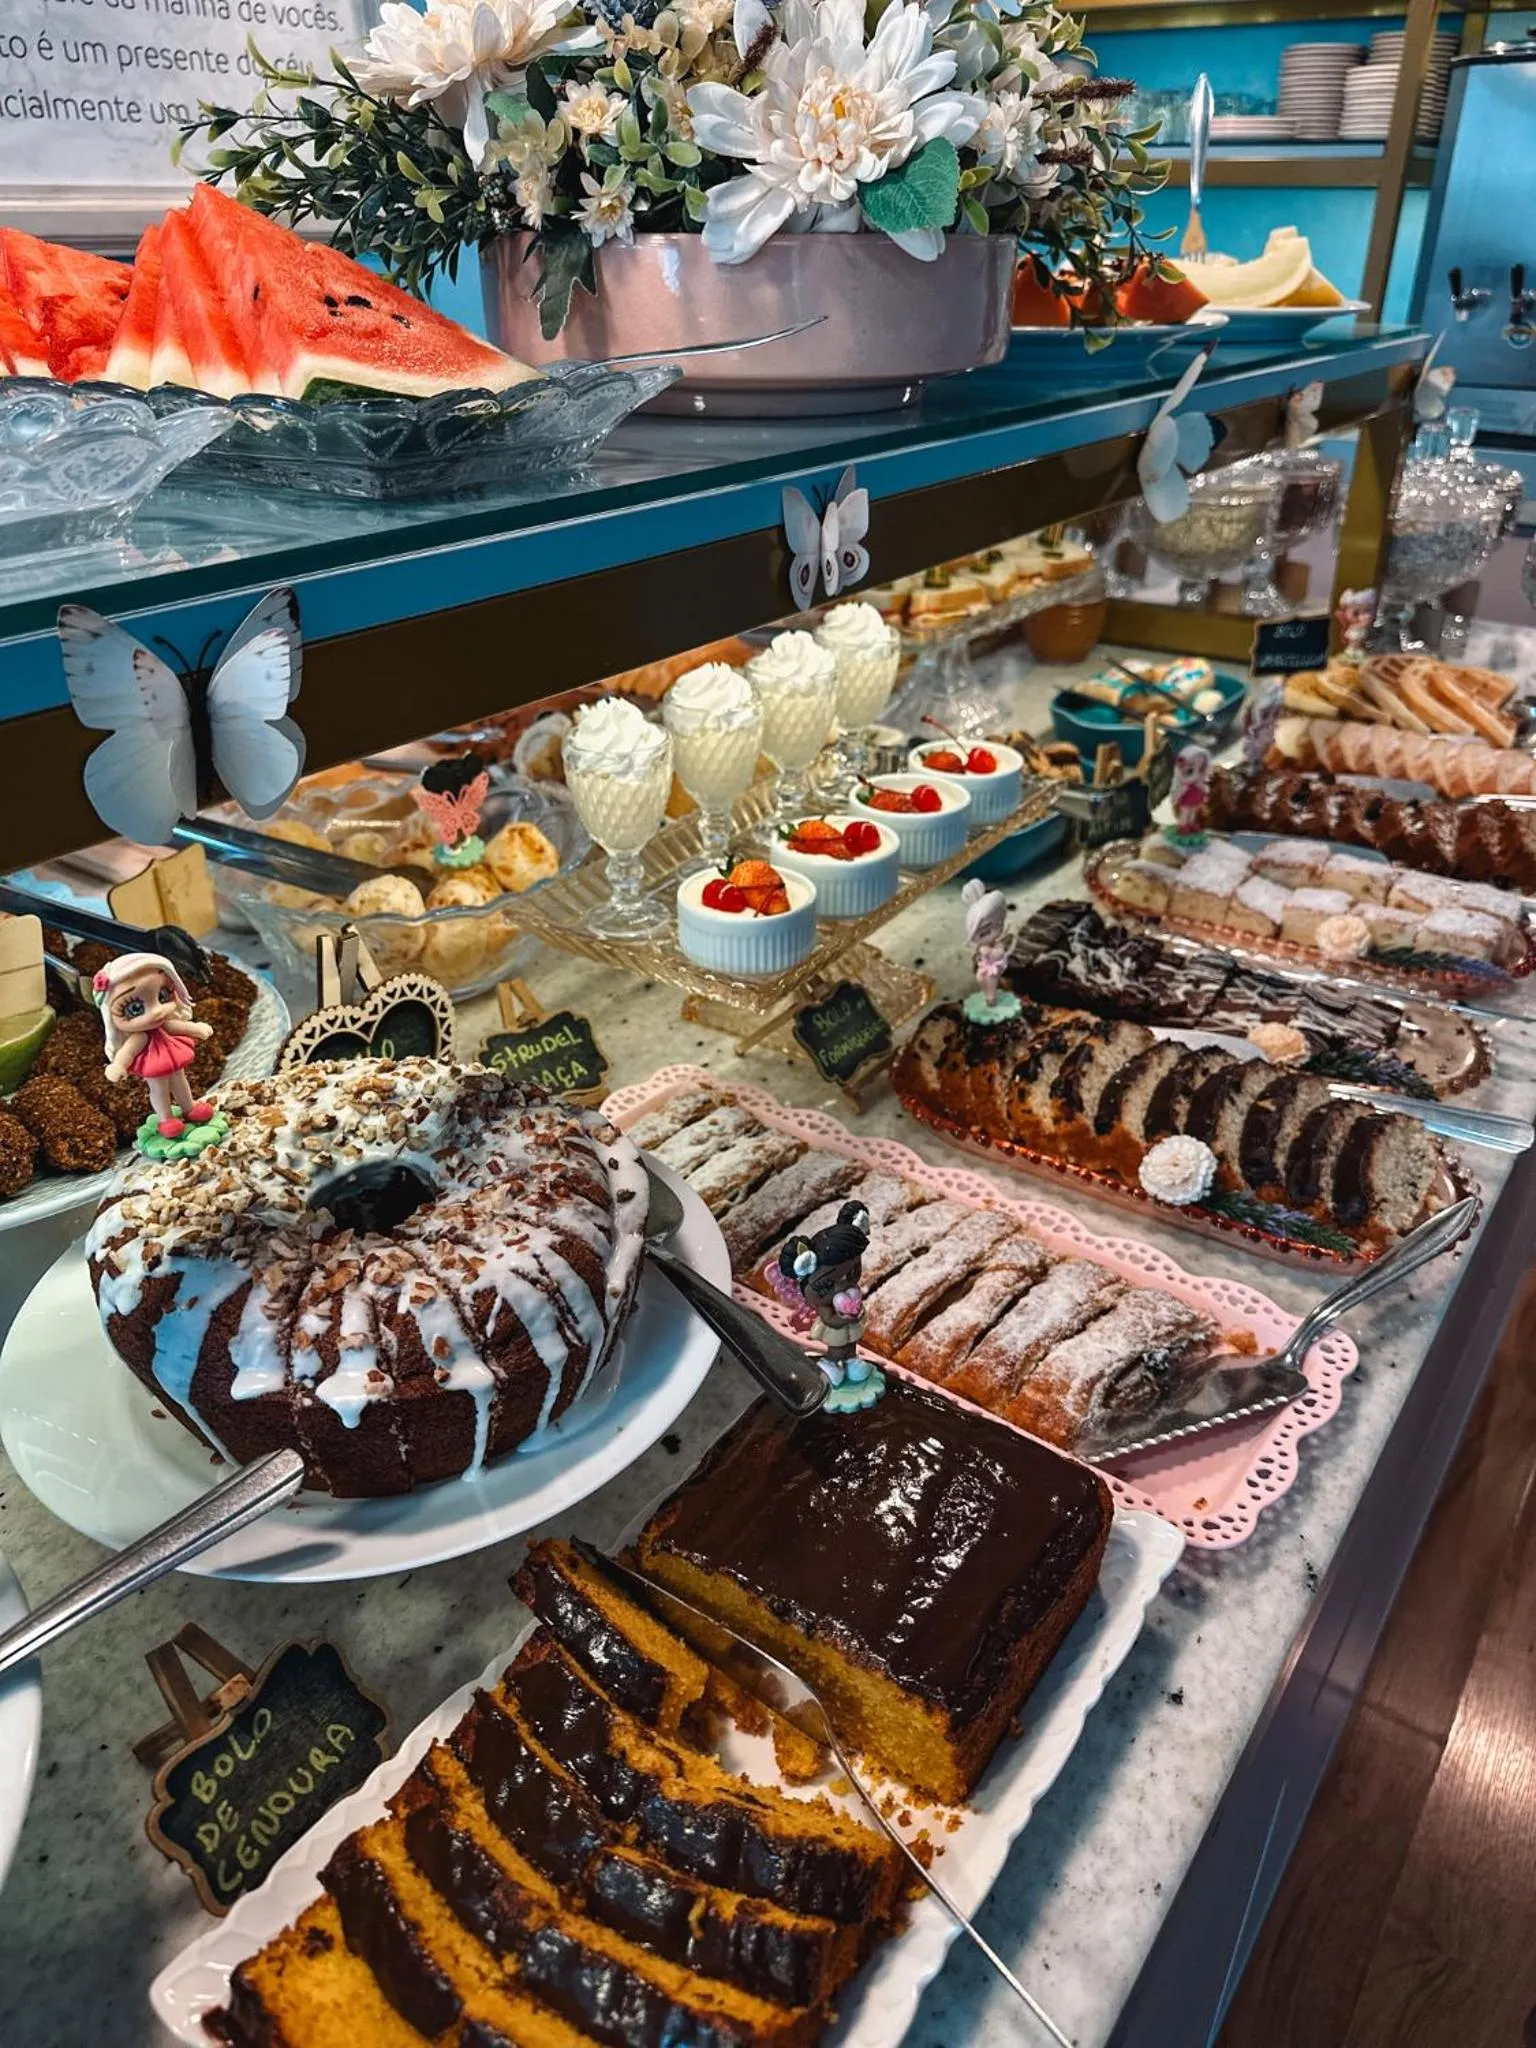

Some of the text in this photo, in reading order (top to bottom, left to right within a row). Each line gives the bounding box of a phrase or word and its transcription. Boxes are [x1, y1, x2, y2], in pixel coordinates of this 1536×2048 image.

[238, 0, 266, 24] de
[272, 3, 344, 32] vocês.
[37, 29, 53, 60] é
[63, 40, 108, 64] um
[117, 44, 229, 74] presente
[191, 1707, 272, 1804] BOLO
[196, 1799, 240, 1854] DE
[217, 1722, 356, 1892] CENOURA
